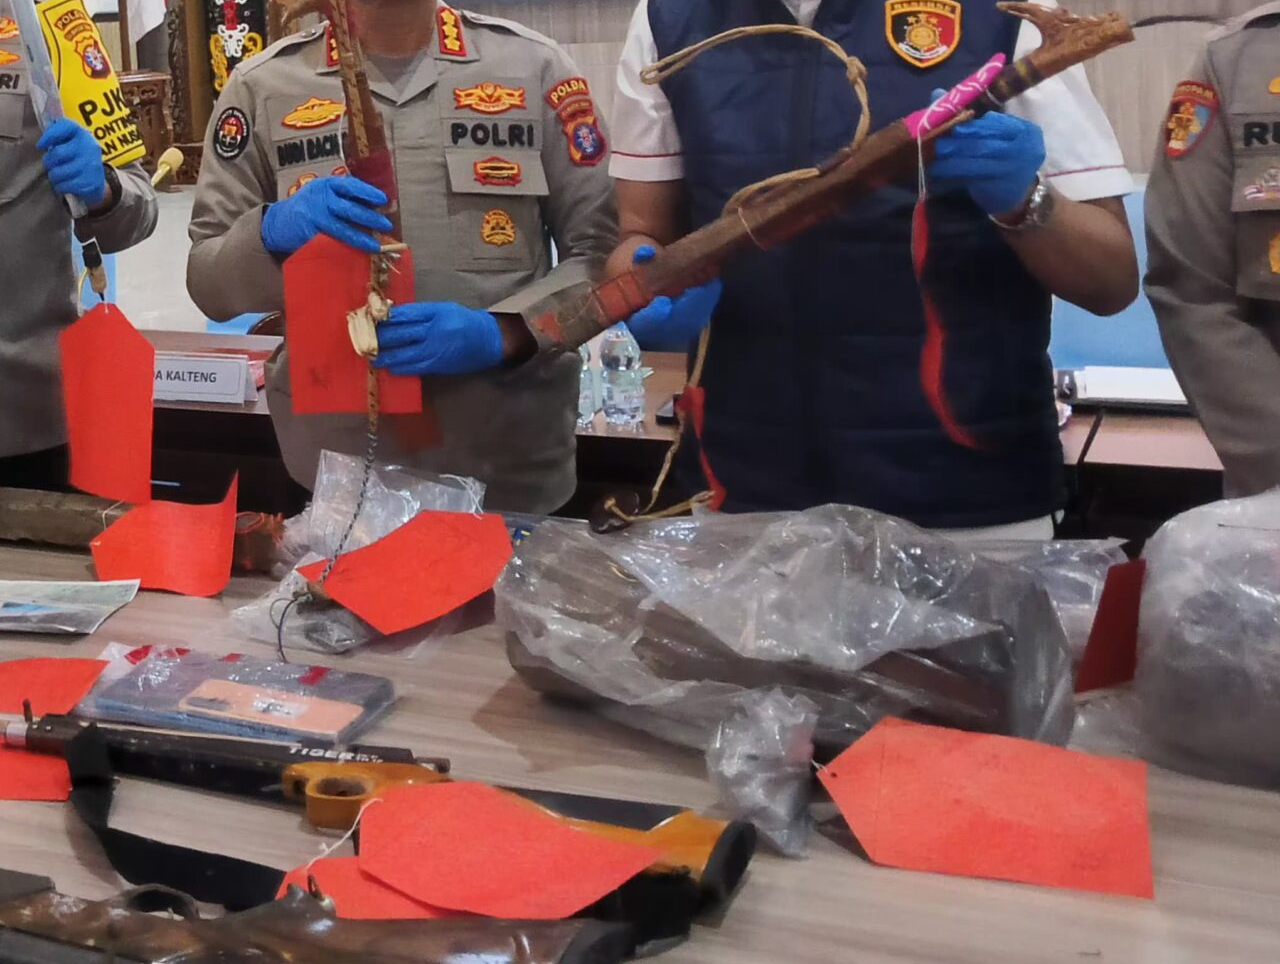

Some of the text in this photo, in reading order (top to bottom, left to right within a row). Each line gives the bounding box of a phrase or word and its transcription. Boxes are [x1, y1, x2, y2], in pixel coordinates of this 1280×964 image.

[550, 79, 586, 104] POLDA
[451, 122, 534, 147] POLRI
[166, 370, 217, 383] KALTENG
[288, 746, 355, 762] TIGER
